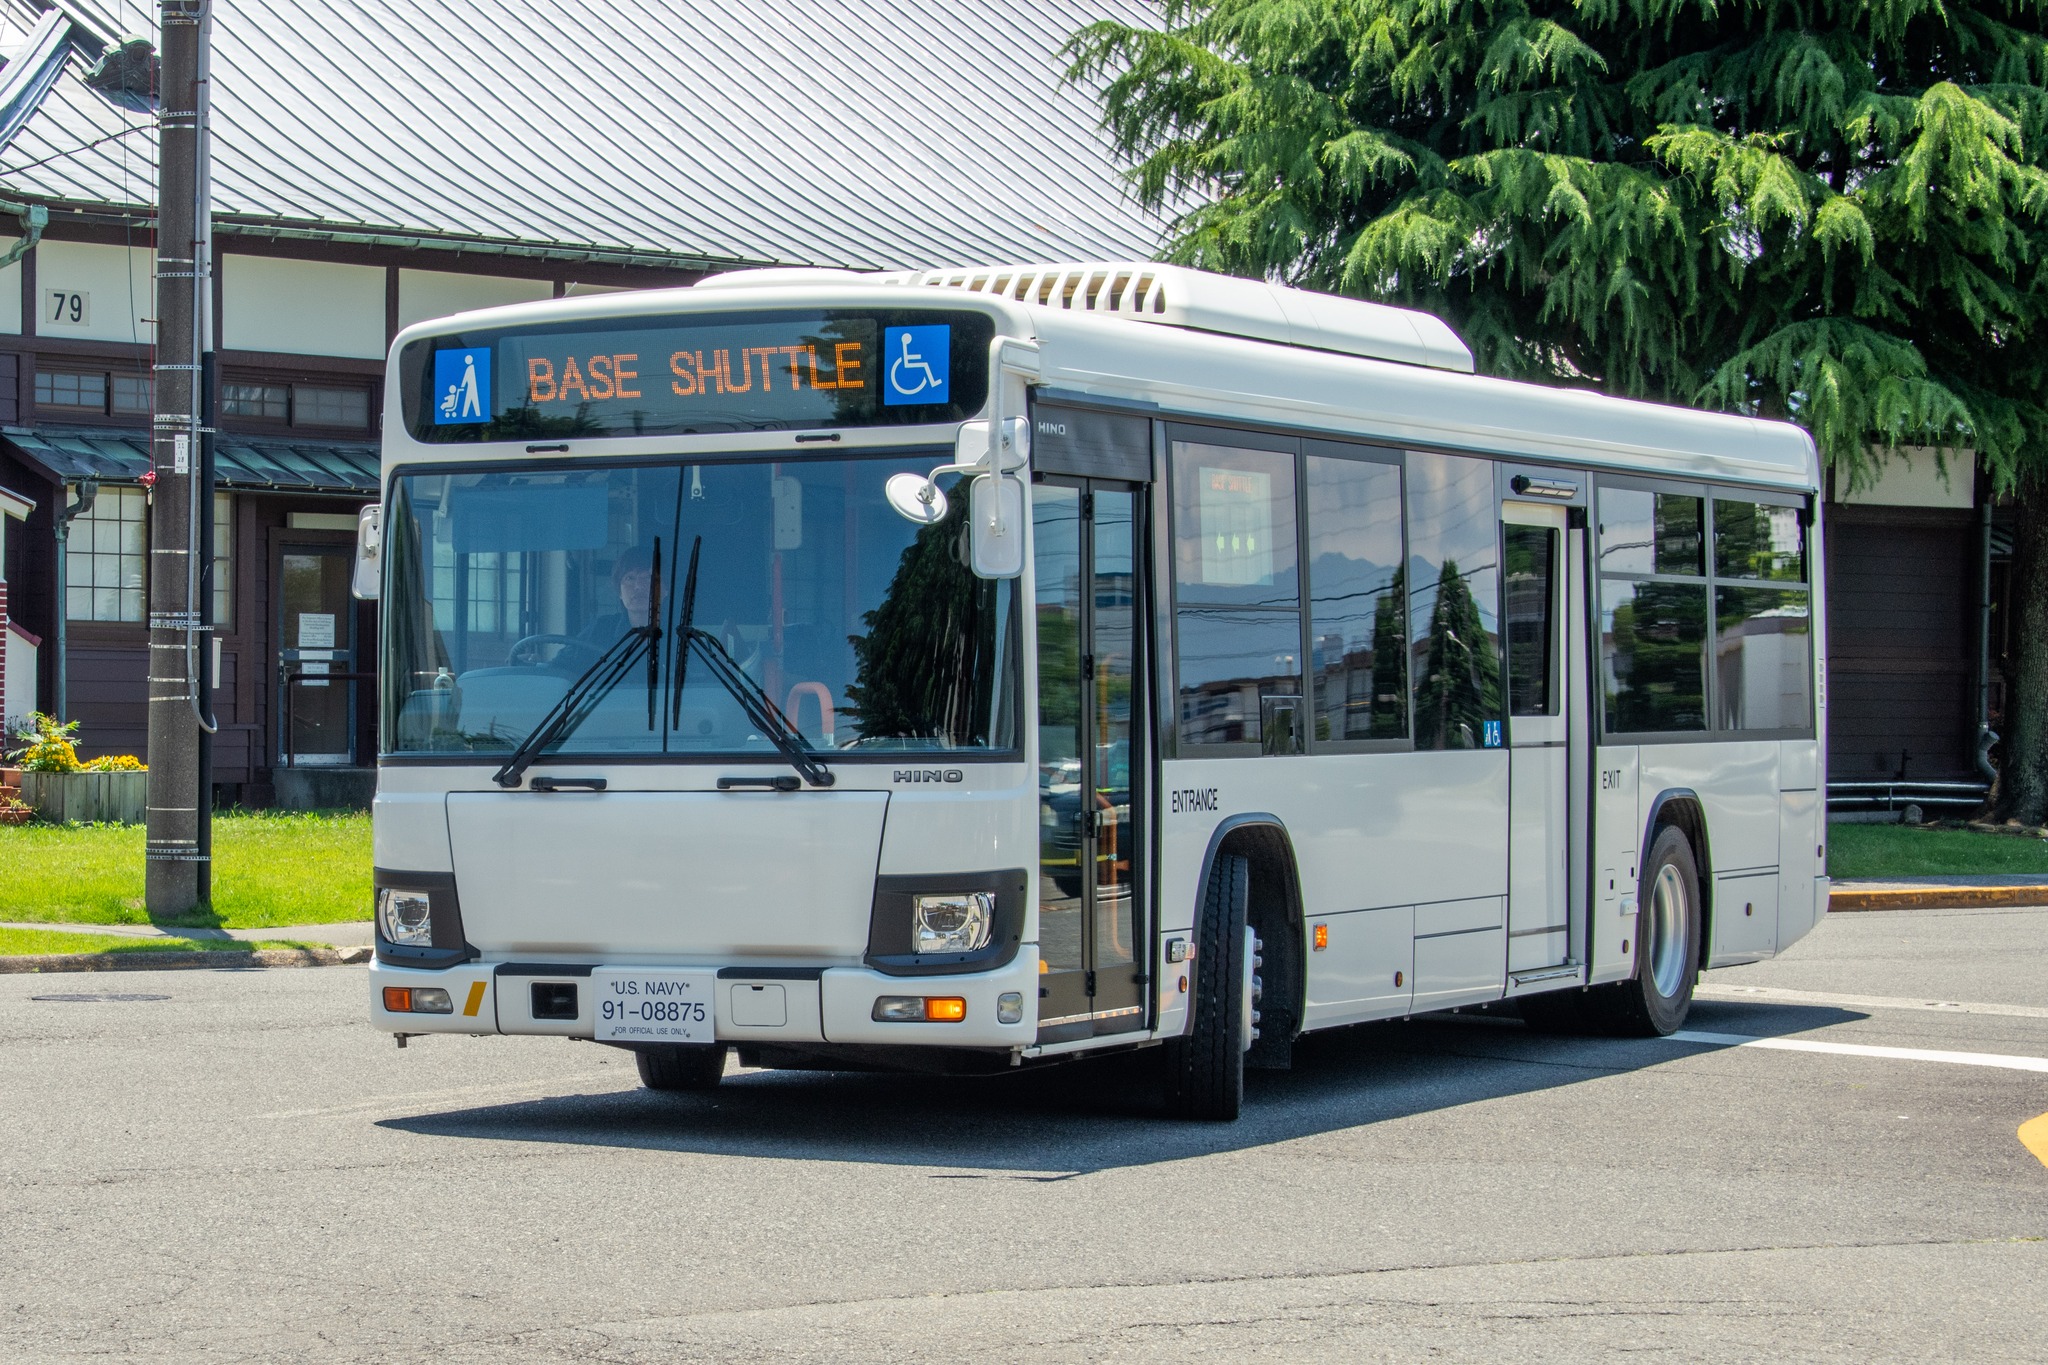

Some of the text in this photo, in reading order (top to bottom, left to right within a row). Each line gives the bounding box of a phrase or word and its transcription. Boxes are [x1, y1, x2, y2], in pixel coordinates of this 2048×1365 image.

[53, 292, 82, 323] 79
[528, 342, 865, 403] BASE SHUTTLE
[1038, 421, 1066, 436] HINO
[893, 769, 964, 783] HINO
[1602, 769, 1621, 790] EXIT
[1172, 787, 1218, 813] ENTRANCE
[615, 981, 686, 996] U.S. NAVY
[602, 1000, 706, 1022] 91-08875
[615, 1026, 687, 1036] FOR OFFICIAL USE ONLY
